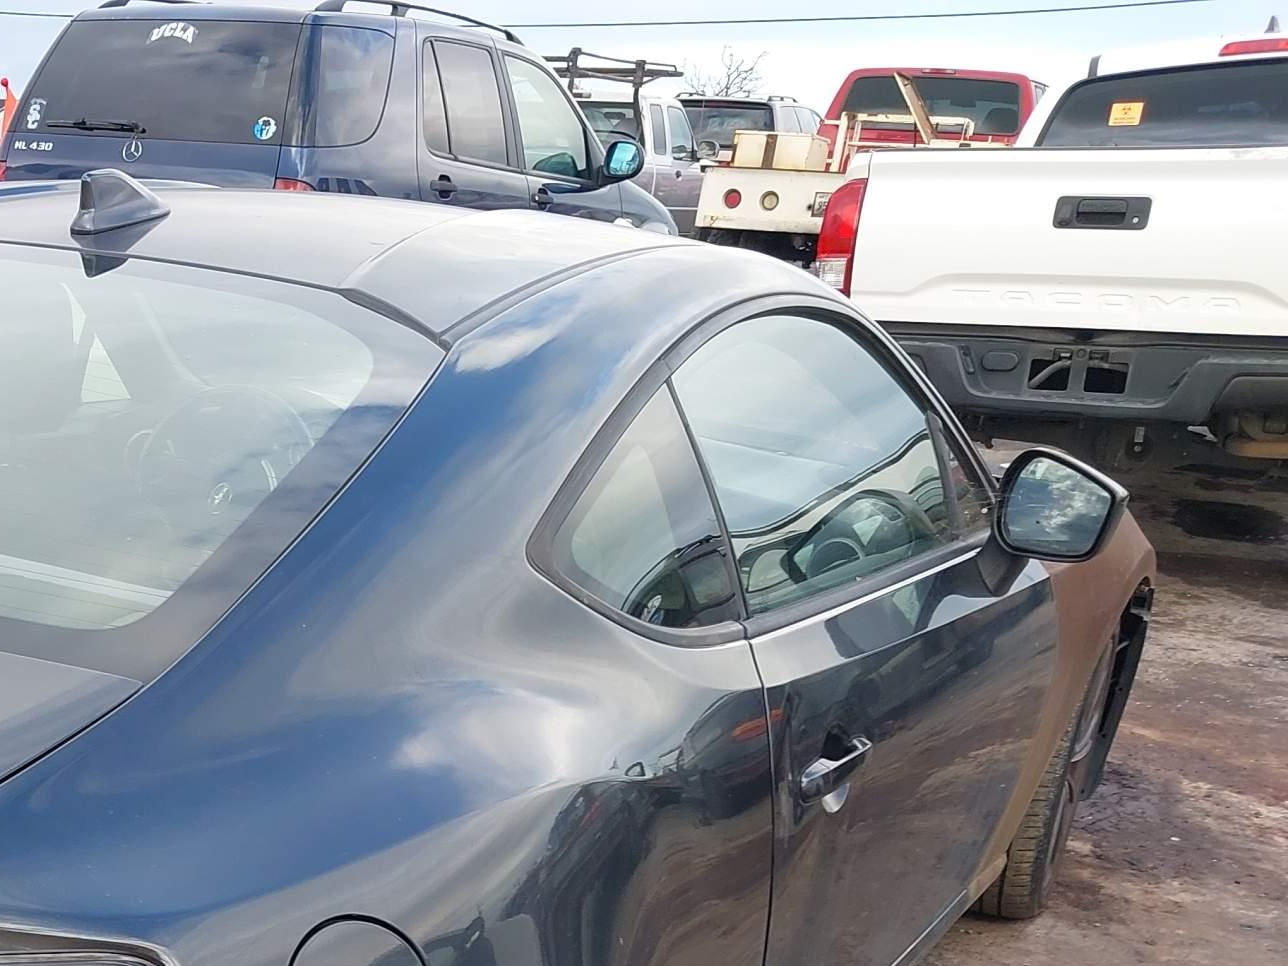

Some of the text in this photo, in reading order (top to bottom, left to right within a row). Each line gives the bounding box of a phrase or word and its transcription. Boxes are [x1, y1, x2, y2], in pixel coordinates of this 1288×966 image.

[150, 22, 195, 44] UCLA
[29, 141, 54, 151] 430
[950, 288, 1242, 314] TACOMA
